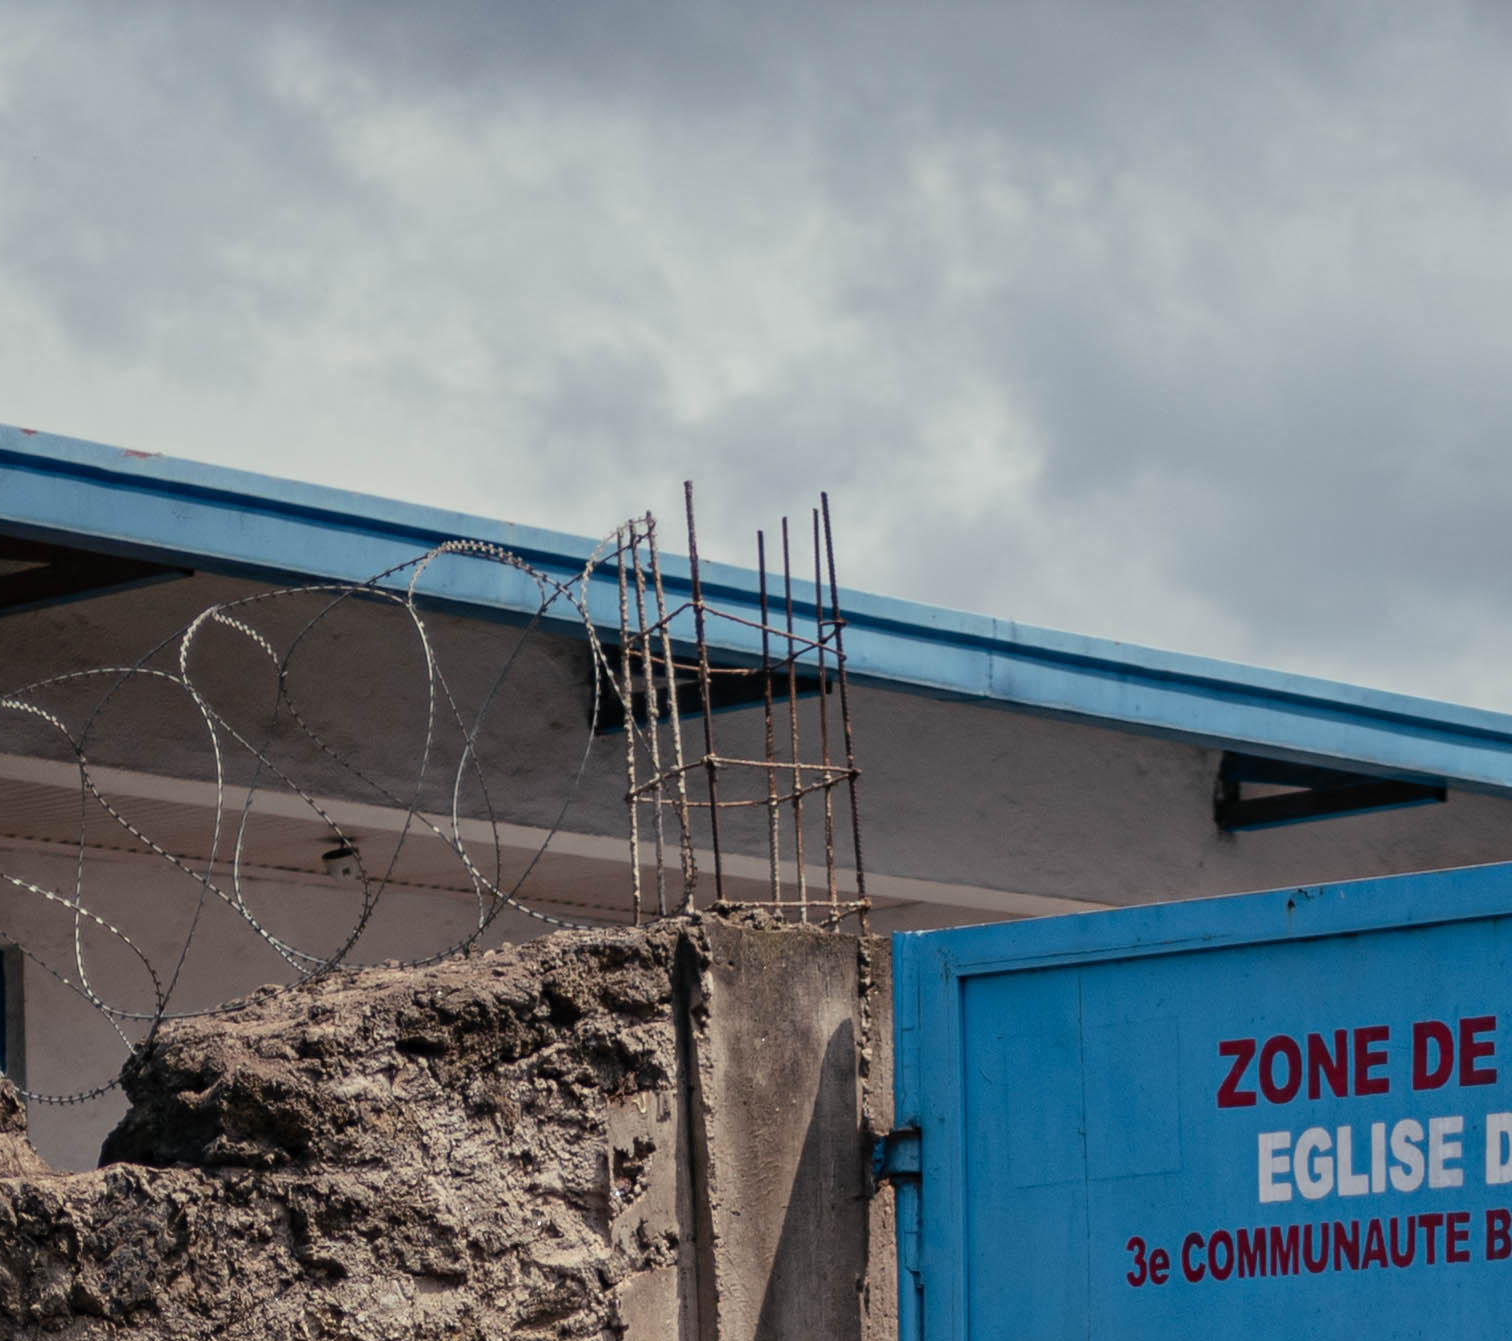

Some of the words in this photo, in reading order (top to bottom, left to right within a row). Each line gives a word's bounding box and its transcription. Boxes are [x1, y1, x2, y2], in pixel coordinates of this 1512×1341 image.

[1217, 1026, 1390, 1108] ZONE
[1412, 1015, 1498, 1091] DE
[1258, 1115, 1464, 1204] EGLISE
[1126, 1236, 1171, 1288] 3e
[1182, 1211, 1471, 1284] COMMUNAUTE
